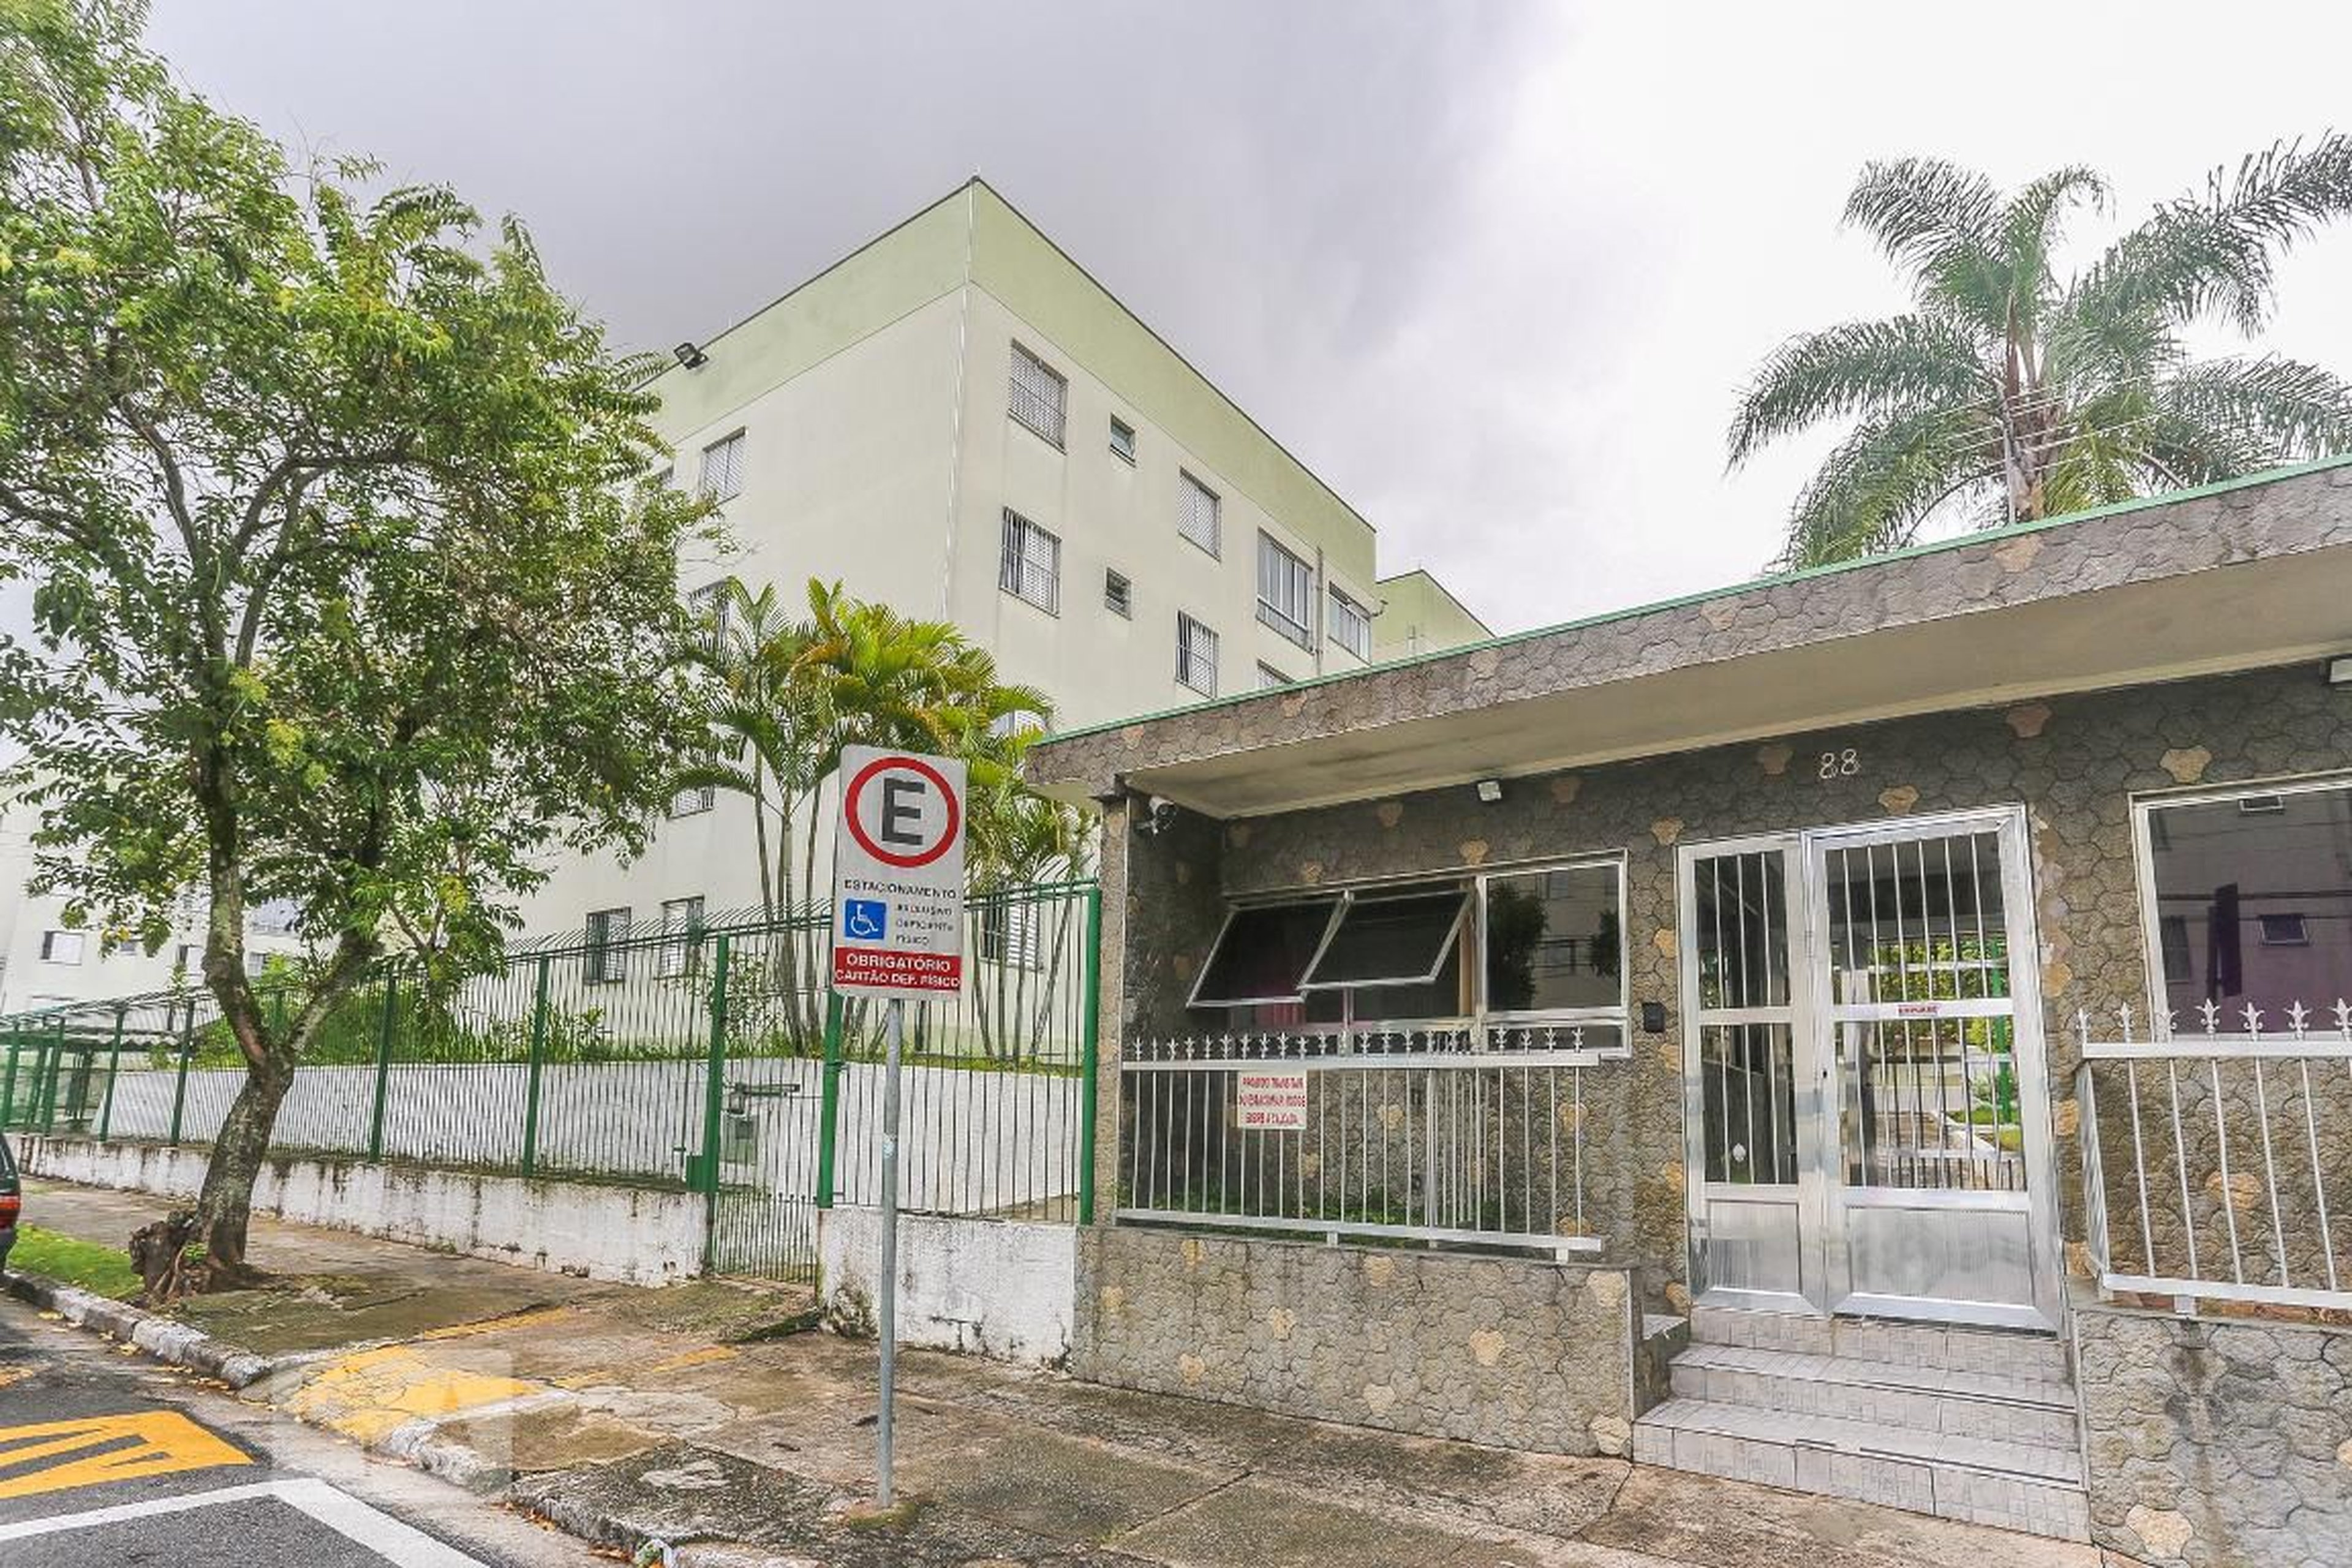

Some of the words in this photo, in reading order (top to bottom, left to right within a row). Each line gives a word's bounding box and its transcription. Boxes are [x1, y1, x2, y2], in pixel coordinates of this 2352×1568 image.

[1819, 748, 1861, 778] 88
[881, 777, 925, 845] E
[845, 879, 956, 899] ESTACIONAMENTO
[846, 953, 950, 973] OBRIGATÓRIO
